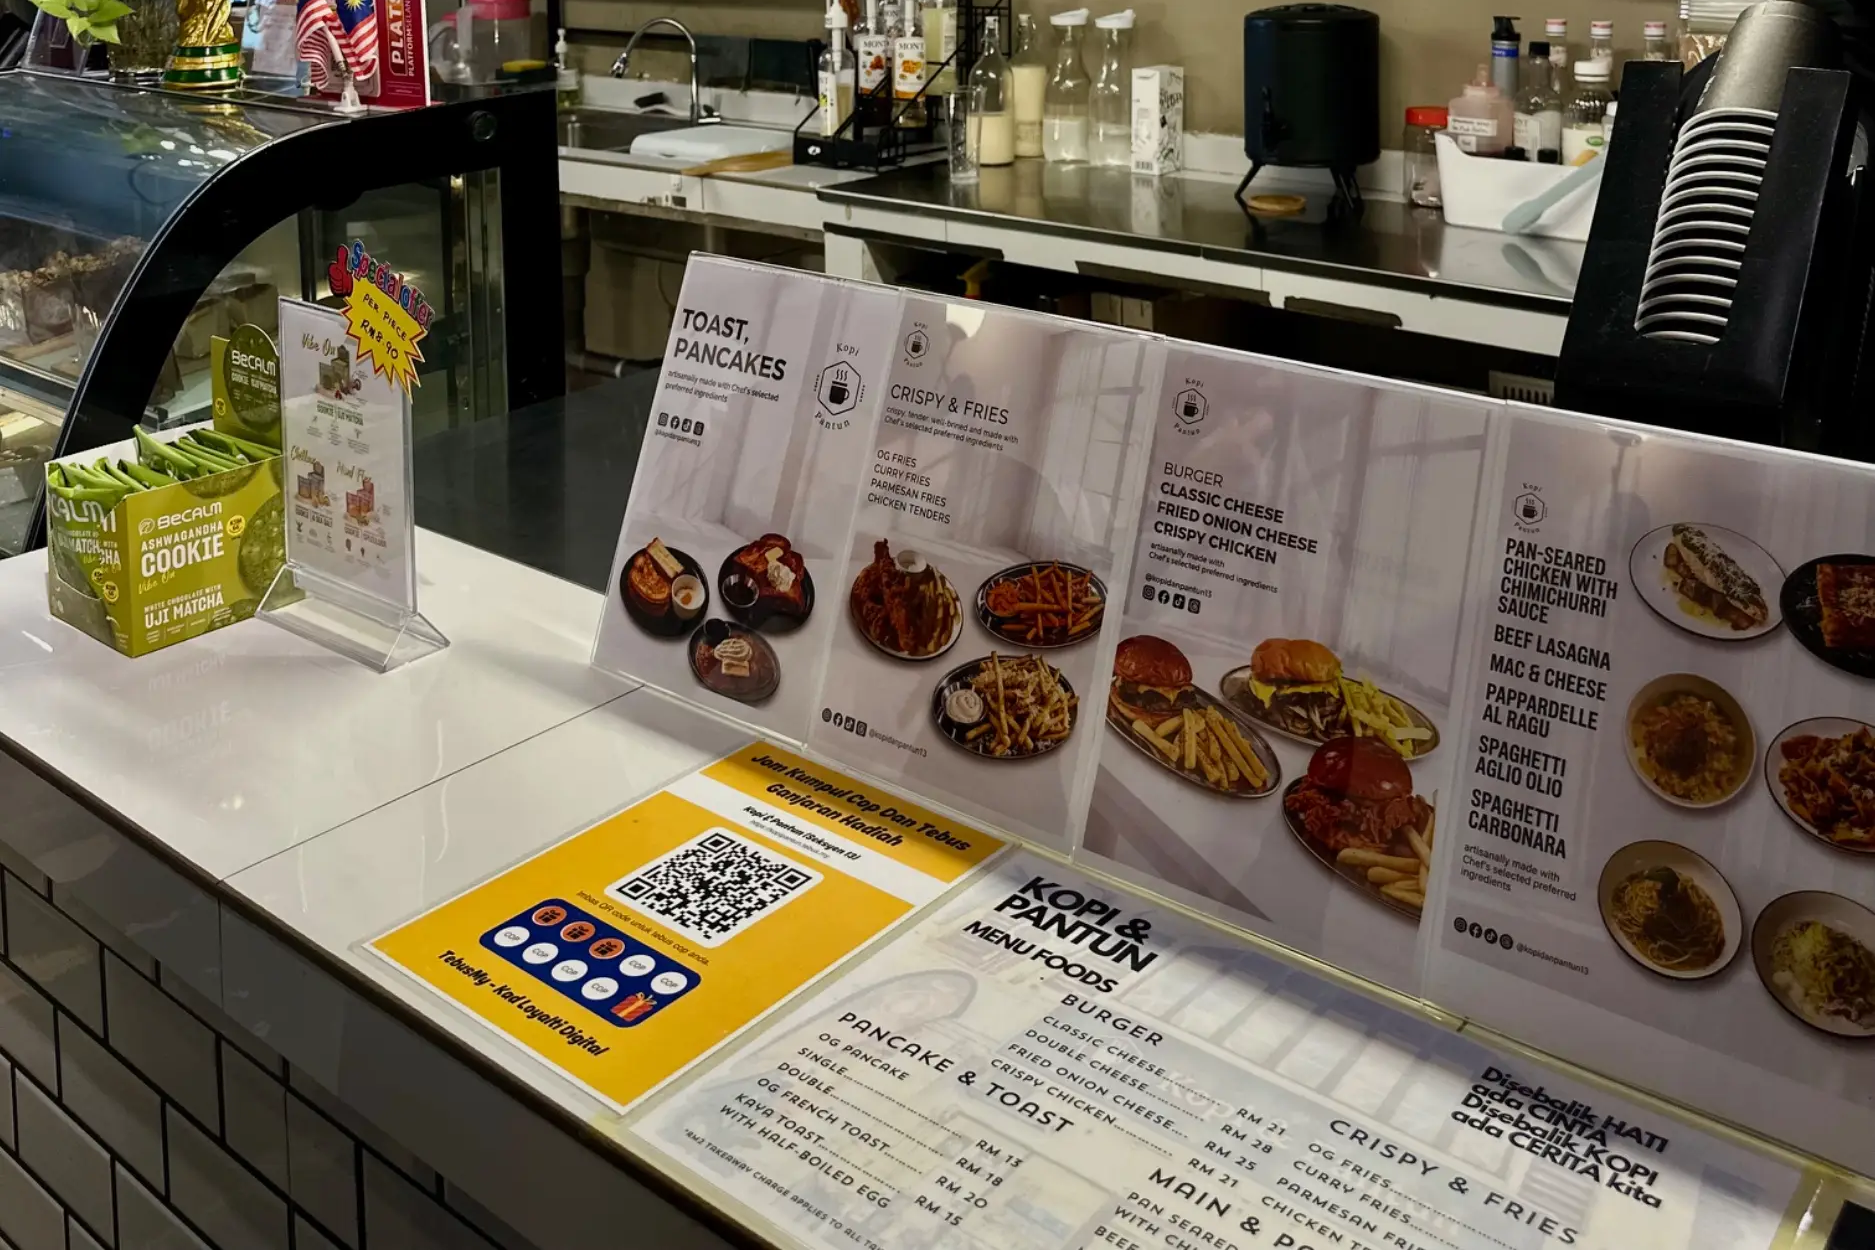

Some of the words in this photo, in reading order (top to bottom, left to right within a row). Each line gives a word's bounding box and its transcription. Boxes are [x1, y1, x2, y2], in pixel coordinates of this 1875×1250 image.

[362, 293, 379, 313] PER
[382, 311, 406, 341] PIECE
[682, 308, 749, 345] TOAST,
[360, 319, 399, 359] RM8.90
[673, 337, 787, 381] PANCAKES
[664, 382, 694, 395] preferred
[693, 389, 728, 403] ingredients
[751, 388, 779, 402] selected
[891, 384, 945, 409] CRISPY
[963, 400, 1010, 425] FRIES
[905, 420, 933, 434] selected
[933, 426, 964, 442] preferred
[873, 463, 904, 480] CURRY
[904, 471, 931, 487] FRIES
[877, 449, 890, 461] OG
[891, 453, 917, 468] FRIES
[1163, 461, 1224, 488] BURGER
[867, 492, 907, 512] CHICKEN
[908, 504, 951, 525] TENDERS
[870, 478, 919, 500] PARMESAN
[920, 491, 947, 508] FRIES
[1160, 481, 1222, 508] CLASSIC
[1223, 497, 1285, 524] CHEESE
[141, 521, 224, 552] ASHWAGANDHA
[1154, 520, 1207, 545] CRISPY
[1208, 534, 1277, 565] CHICKEN
[1157, 501, 1200, 523] FRIED
[1202, 512, 1253, 539] ONION
[1255, 526, 1318, 554] CHEESE
[141, 533, 225, 578] COOKIE
[1150, 542, 1186, 558] artisanally
[1187, 552, 1207, 562] made
[1208, 557, 1225, 568] with
[1171, 557, 1200, 571] selected
[1201, 566, 1235, 581] preferred
[1505, 537, 1606, 576] PAN-SEARED
[1500, 576, 1607, 618] CHIMICHURRI
[1503, 557, 1572, 589] CHICKEN
[1575, 572, 1618, 600] WITH
[144, 609, 169, 629] UJI
[173, 591, 224, 620] MATCHA
[1497, 595, 1550, 624] SAUCE
[1494, 624, 1534, 650] BEEF
[1536, 635, 1611, 671] LASAGNA
[1490, 653, 1525, 679] MAC
[1544, 668, 1608, 702] CHEESE
[1482, 703, 1503, 725] AL
[1506, 711, 1551, 739] RAGU
[1485, 682, 1599, 731] PAPPARDELLE
[1478, 734, 1566, 778] SPAGHETTI
[1475, 756, 1522, 787] AGLIO
[1525, 770, 1563, 799] OLIO
[751, 754, 788, 774] Jom
[785, 766, 852, 799] Kumpul
[846, 792, 882, 814] Cop
[879, 807, 917, 829] Dan
[916, 821, 972, 852] Tebus
[766, 782, 843, 821] Ganjaran
[839, 814, 905, 847] Hadiah
[1471, 788, 1560, 834] SPAGHETTI
[1468, 810, 1567, 860] CARBONARA
[1460, 867, 1512, 892] ingredients
[1464, 844, 1510, 867] artisanally
[1512, 859, 1538, 875] made
[1540, 867, 1560, 883] with
[1493, 865, 1532, 886] selected
[1532, 880, 1577, 902] preferred
[576, 890, 599, 906] Imbas
[611, 908, 630, 922] code
[630, 919, 652, 934] untuk
[651, 930, 673, 946] tebus
[1018, 876, 1121, 927] KOPI
[1114, 918, 1151, 946] &
[994, 893, 1158, 973] PANTUN
[963, 920, 1036, 955] MENU
[1030, 948, 1119, 993] FOODS
[438, 949, 492, 986] TebusMy
[493, 984, 519, 1006] Kad
[559, 1023, 610, 1057] Digital
[1060, 993, 1164, 1047] BURGER
[1025, 1029, 1087, 1062] DOUBLE
[1043, 1016, 1104, 1048] CLASSIC
[819, 1033, 841, 1047] OG
[842, 1043, 910, 1082] PANCAKE
[838, 1012, 955, 1074] PANCAKE
[957, 1070, 977, 1086] &
[985, 1082, 1075, 1132] TOAST
[777, 1062, 835, 1096] DOUBLE
[990, 1058, 1045, 1088] CRISPY
[1047, 1085, 1117, 1125] CHICKEN
[1008, 1043, 1053, 1069] FRIED
[1056, 1067, 1109, 1097] ONION
[1113, 1094, 1175, 1130] CHEESE
[735, 1093, 775, 1119] KAYA
[757, 1078, 781, 1094] OG
[781, 1090, 839, 1125] FRENCH
[1236, 1107, 1263, 1125] RM
[1267, 1122, 1287, 1136] 21
[1471, 1083, 1524, 1111] ada
[1527, 1103, 1607, 1147] CINTA
[1481, 1066, 1599, 1124] Disebalik
[1601, 1115, 1670, 1153] HATI
[719, 1104, 756, 1130] WITH
[757, 1125, 854, 1187] HALF-BOILED
[857, 1183, 891, 1209] EGG
[975, 1139, 1002, 1157] RM
[1004, 1155, 1024, 1168] 13
[1204, 1140, 1232, 1158] RM
[1235, 1156, 1257, 1171] 25
[1220, 1124, 1247, 1141] RM
[1251, 1138, 1273, 1154] 28
[1308, 1142, 1335, 1161] OG
[1451, 1110, 1504, 1138] ada
[1507, 1131, 1601, 1183] CERITA
[1605, 1172, 1663, 1209] kita
[1461, 1092, 1580, 1153] Disebalik
[1583, 1143, 1659, 1187] KOPI
[704, 1141, 752, 1174] TAKEAWAY
[752, 1170, 791, 1198] CHARGE
[790, 1194, 828, 1221] APPLIES
[828, 1217, 844, 1230] TO
[844, 1227, 862, 1243] ALL
[935, 1175, 961, 1194] RM
[963, 1191, 988, 1209] 20
[955, 1157, 981, 1175] RM
[985, 1173, 1004, 1187] 18
[1187, 1157, 1215, 1176] RM
[1218, 1173, 1239, 1188] 21
[1292, 1160, 1355, 1194] CURRY
[1329, 1119, 1440, 1176] CRISPY
[1448, 1176, 1470, 1195] &
[1483, 1191, 1579, 1246] FRIES
[914, 1195, 940, 1214] RM
[944, 1212, 963, 1227] 15
[1115, 1206, 1160, 1236] WITH
[1127, 1191, 1164, 1216] PAN
[1148, 1167, 1231, 1218] MAIN
[1240, 1216, 1261, 1235] &
[1261, 1195, 1343, 1243] CHICKEN
[1276, 1176, 1379, 1233] PARMESAN
